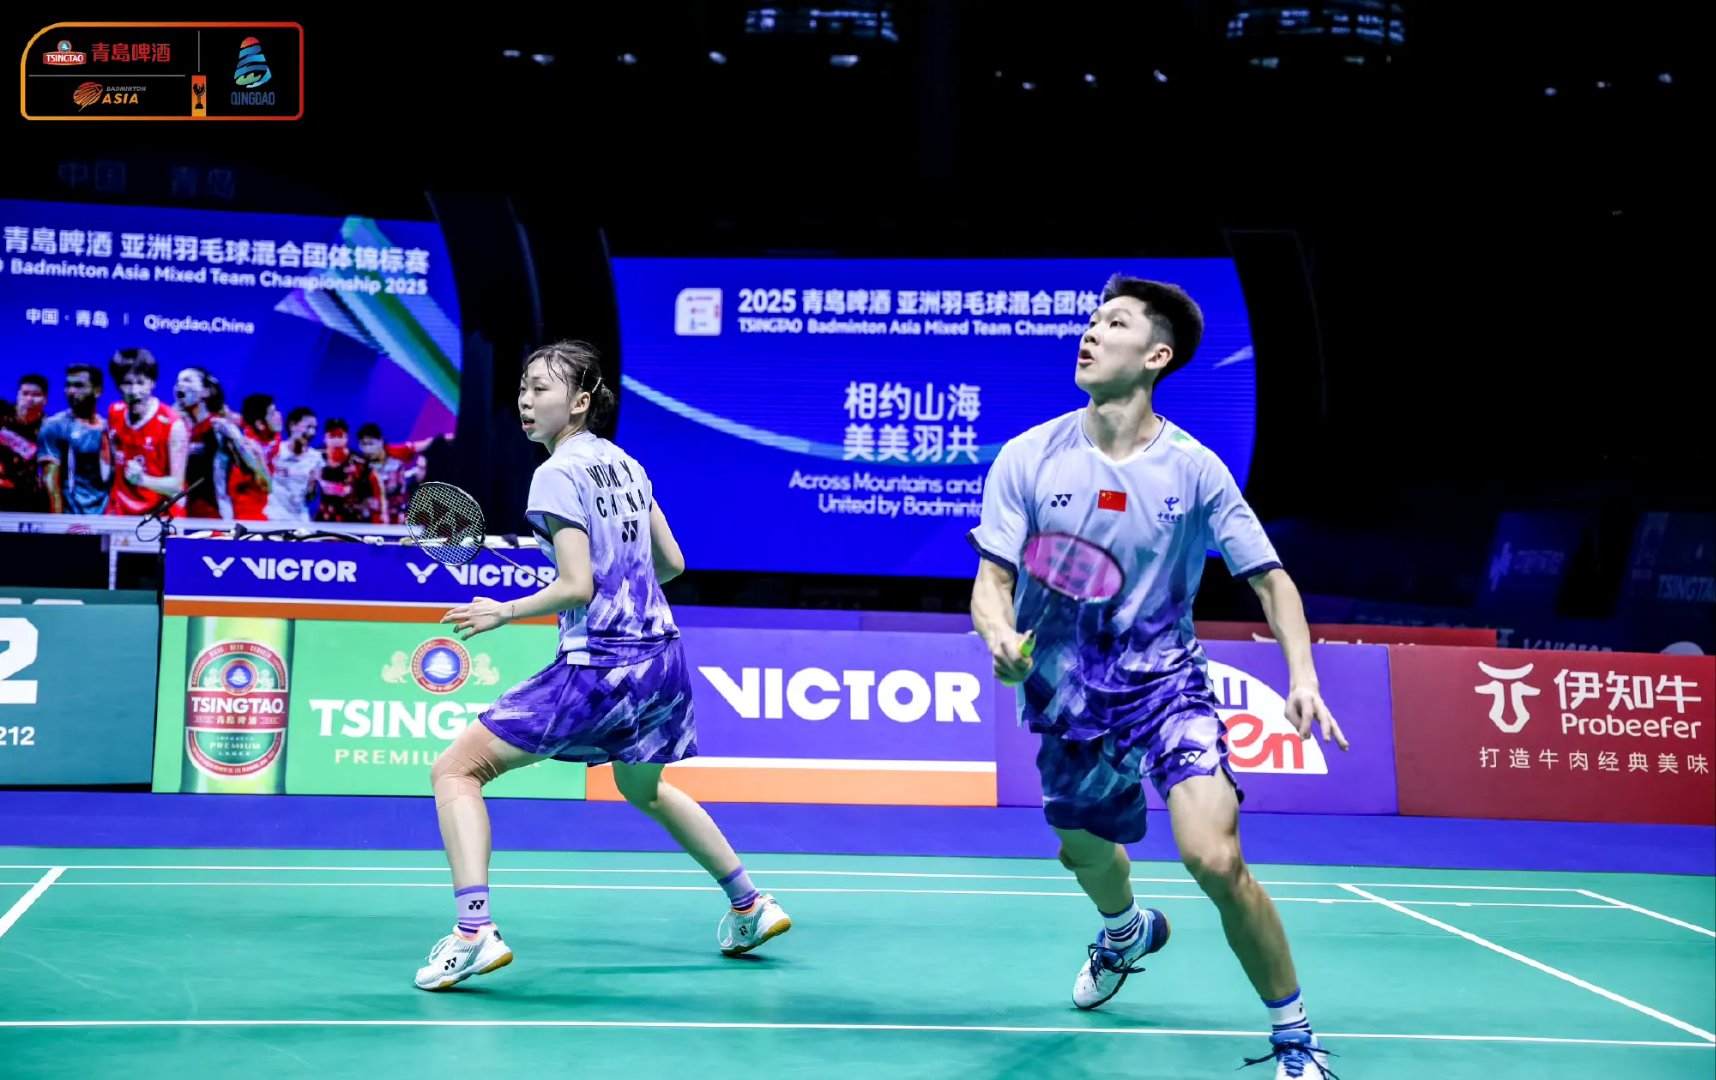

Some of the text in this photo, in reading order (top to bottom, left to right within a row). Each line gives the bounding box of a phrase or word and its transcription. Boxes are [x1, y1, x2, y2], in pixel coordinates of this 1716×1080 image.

[10, 257, 109, 279] Badminton
[111, 262, 151, 281] Asia
[154, 265, 207, 284] Mixed
[209, 267, 256, 287] Team
[259, 270, 382, 295] Championship
[384, 277, 428, 295] 2025
[738, 288, 797, 313] 2025
[897, 289, 1104, 316] 亚洲羽毛球混合团体
[807, 317, 887, 335] Badminton
[889, 319, 921, 335] Asia
[924, 319, 969, 336] Mixed
[972, 320, 1012, 336] Team
[843, 381, 982, 422] 相约山海
[842, 422, 980, 464] 美美羽共
[789, 470, 982, 495] Across Mountains and
[595, 488, 646, 518] CHNA
[818, 493, 876, 515] United
[877, 496, 900, 518] by
[241, 557, 357, 583] VICTOR
[445, 564, 556, 588] VICTOR
[697, 666, 981, 722] VICTOR
[1554, 669, 1702, 713] 伊知牛
[191, 697, 284, 714] TSINGTAO
[1561, 713, 1702, 739] Probeefer
[1479, 746, 1709, 775] 打造牛肉经典美味
